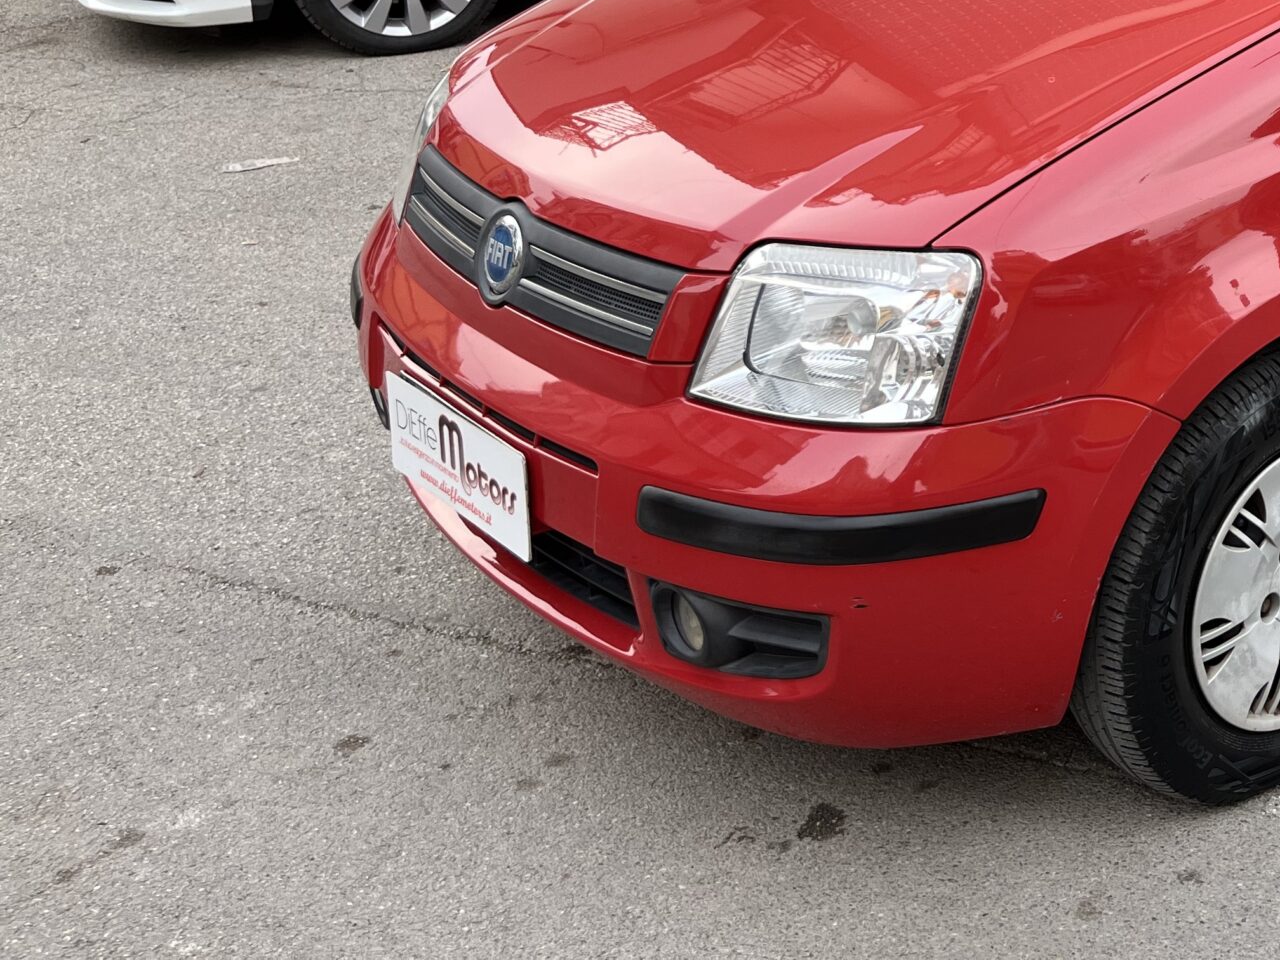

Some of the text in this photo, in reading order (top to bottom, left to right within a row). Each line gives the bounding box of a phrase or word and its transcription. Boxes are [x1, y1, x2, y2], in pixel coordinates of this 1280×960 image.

[486, 237, 513, 269] FIAT
[395, 398, 438, 450] DiEffe
[439, 414, 517, 515] Motors
[420, 468, 493, 526] www.dieffemotors.it
